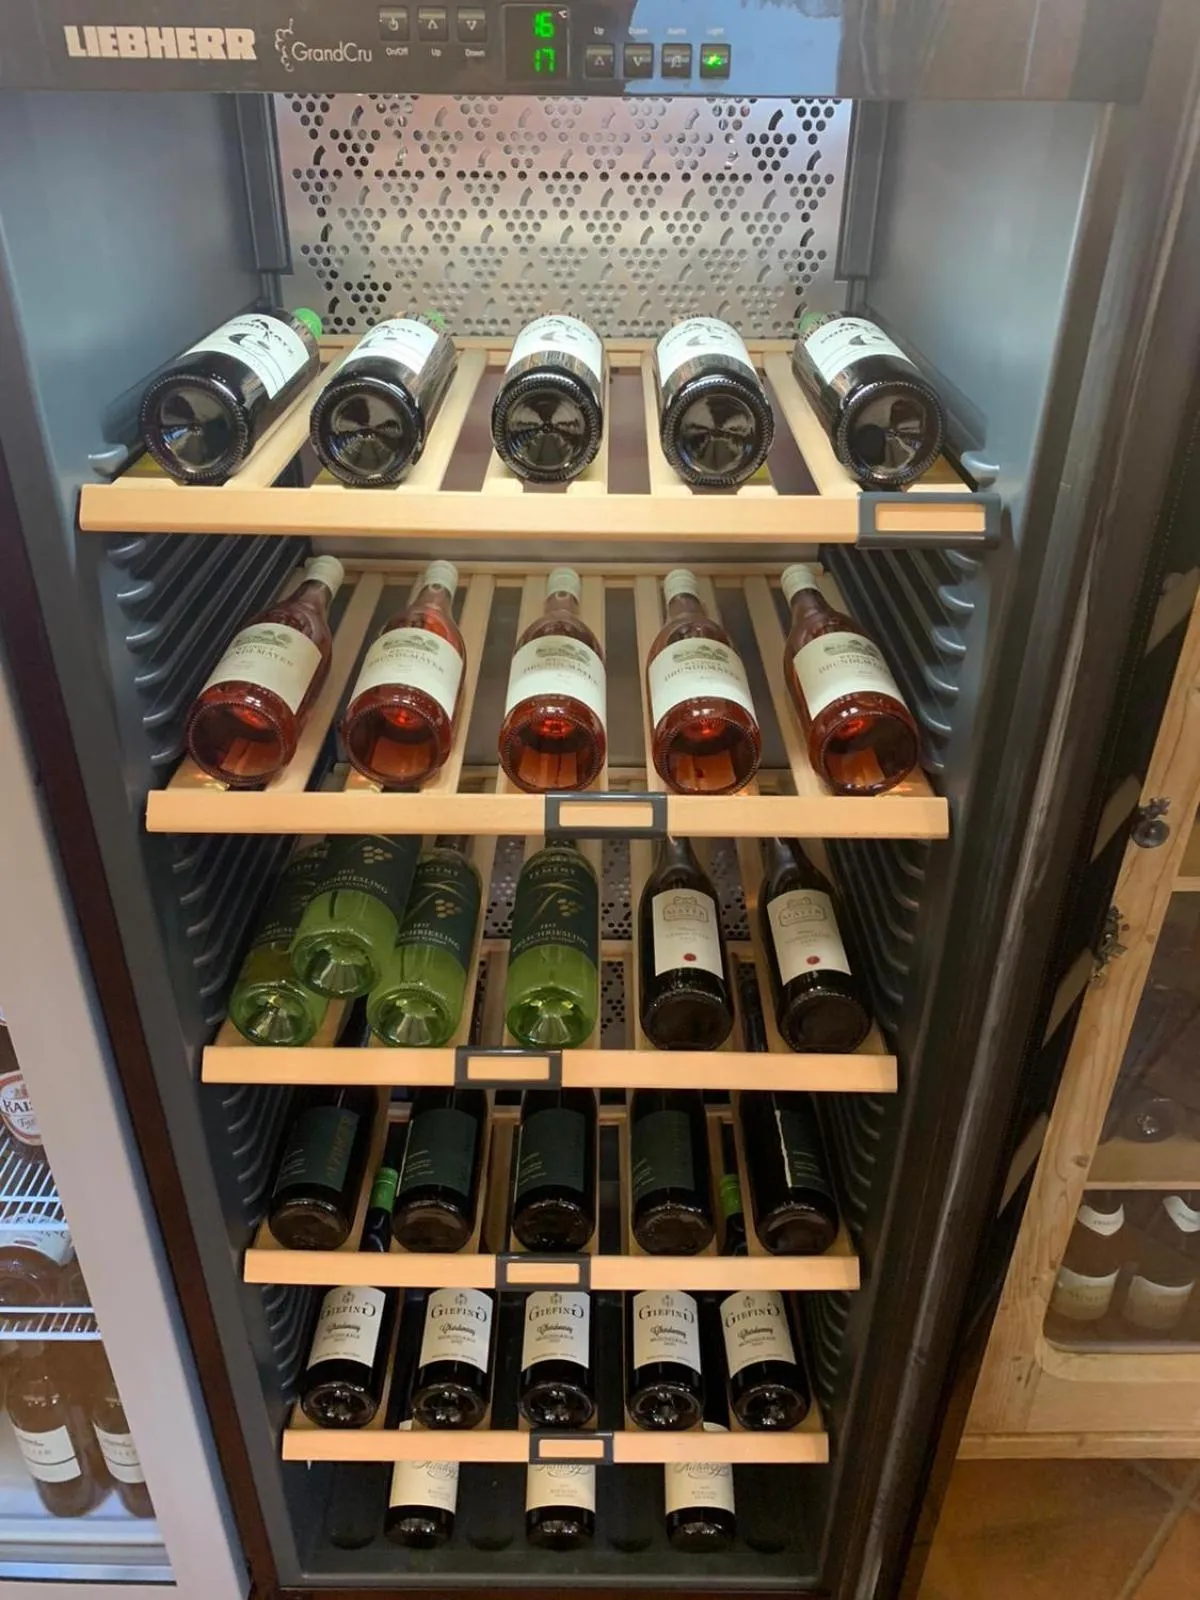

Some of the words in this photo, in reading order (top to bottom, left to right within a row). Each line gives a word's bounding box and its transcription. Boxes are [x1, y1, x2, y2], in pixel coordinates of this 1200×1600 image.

[535, 10, 554, 38] 16
[64, 25, 257, 60] LIEBHERR
[291, 42, 373, 63] GrandCru
[386, 47, 408, 56] On/Off
[431, 48, 442, 57] Up
[464, 48, 486, 57] Down
[535, 48, 555, 72] 17
